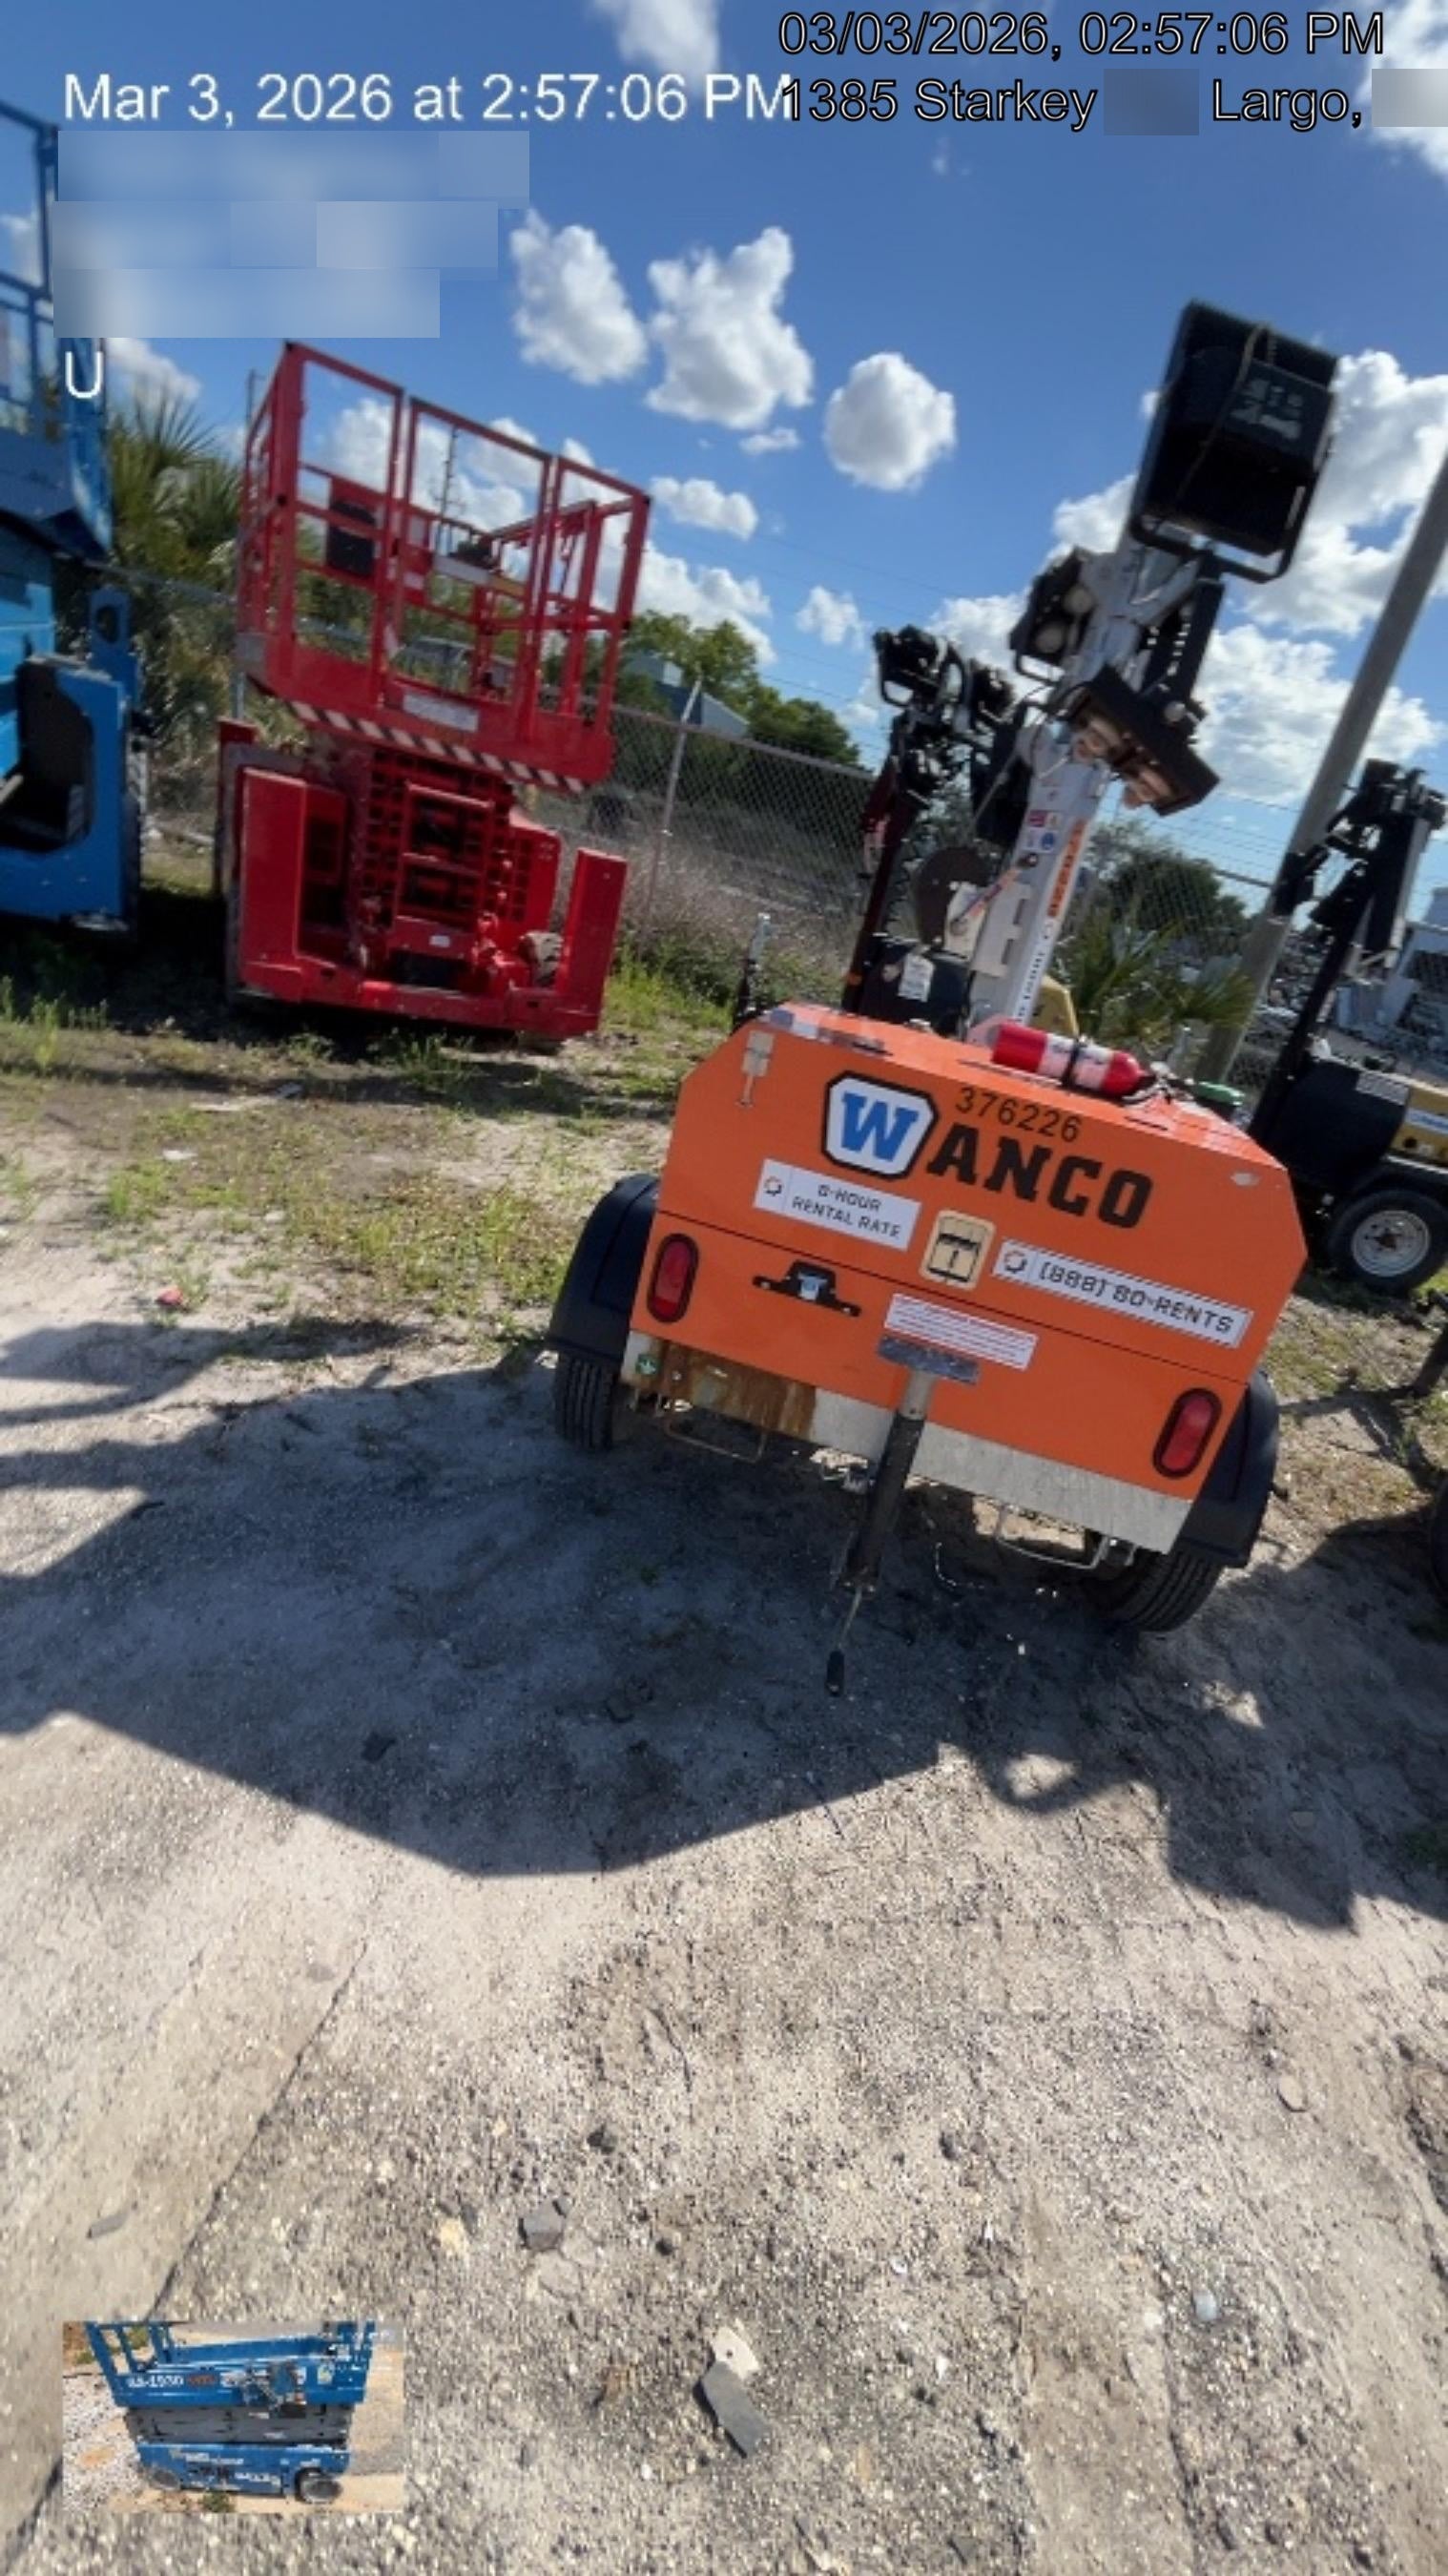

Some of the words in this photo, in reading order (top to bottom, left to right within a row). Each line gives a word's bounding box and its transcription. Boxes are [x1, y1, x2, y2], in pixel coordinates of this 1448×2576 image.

[956, 1086, 1083, 1143] 376226
[840, 1091, 1154, 1229] WANCO
[792, 1195, 853, 1226] RENTAL
[858, 1215, 900, 1238] RATE
